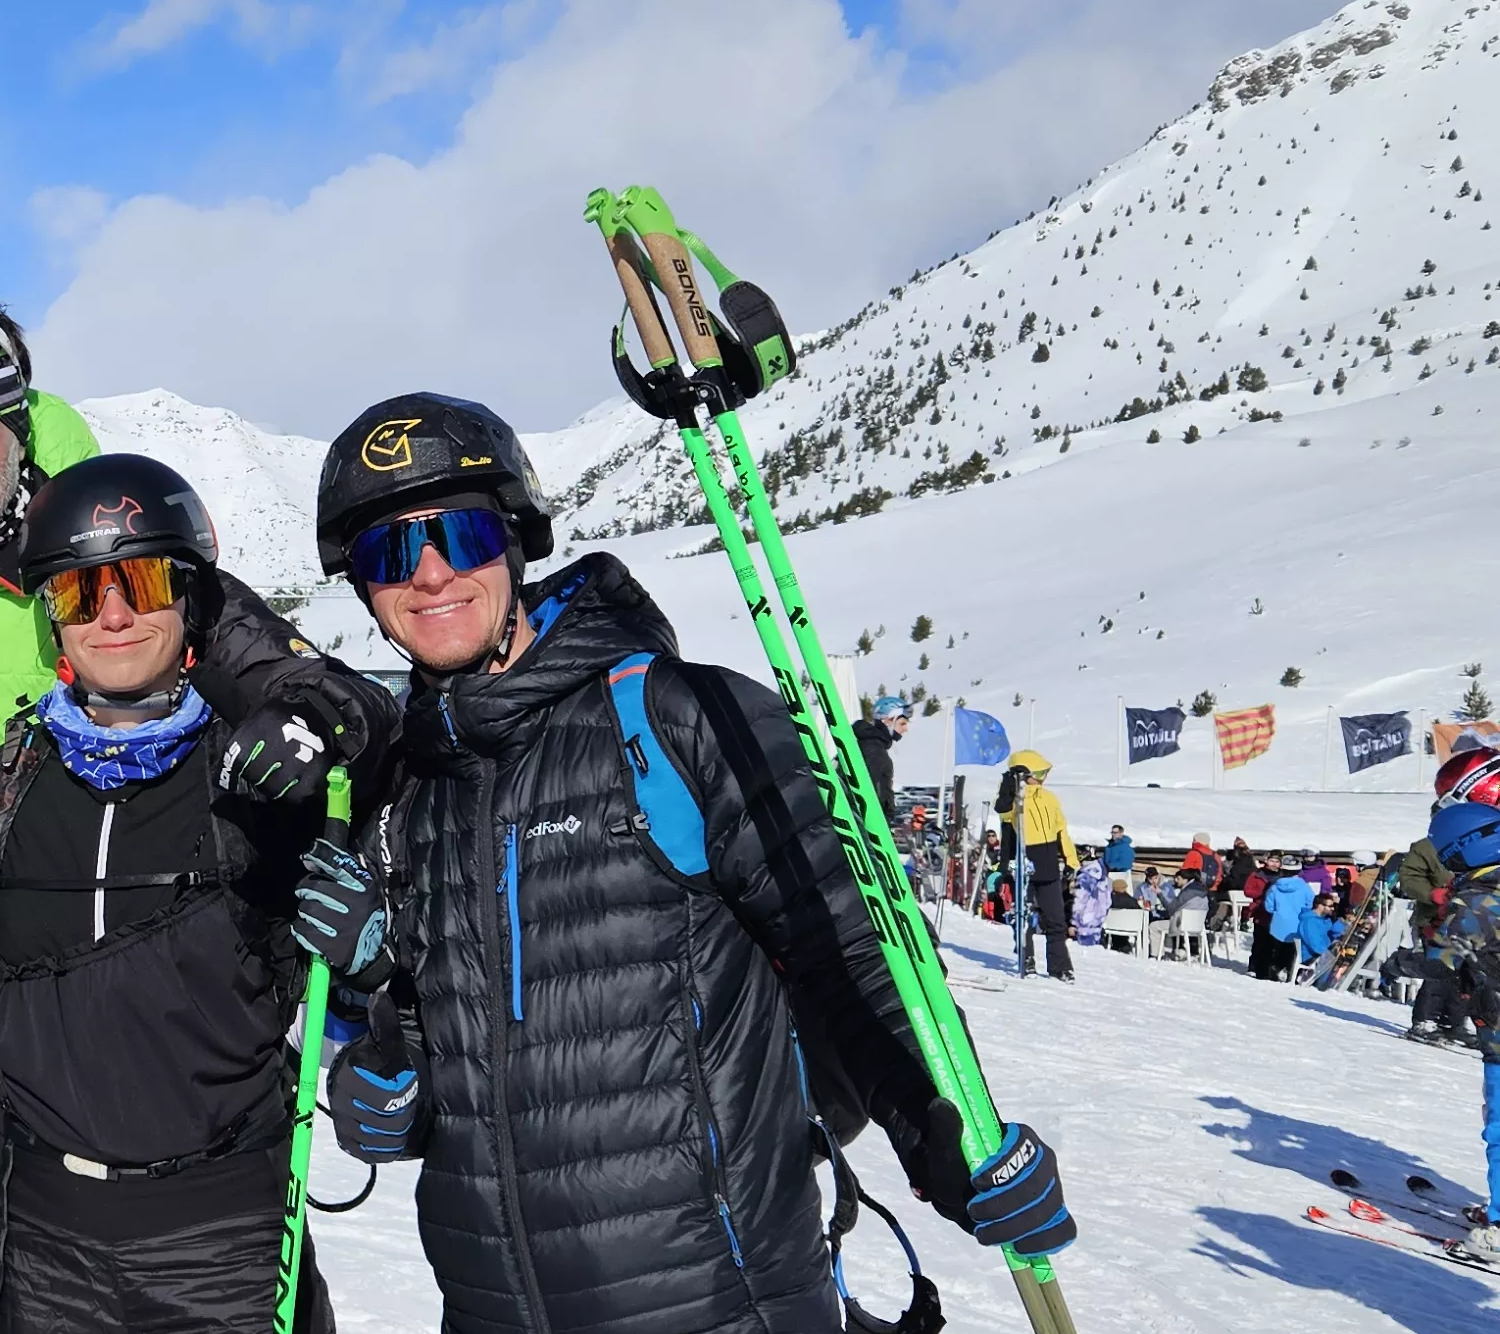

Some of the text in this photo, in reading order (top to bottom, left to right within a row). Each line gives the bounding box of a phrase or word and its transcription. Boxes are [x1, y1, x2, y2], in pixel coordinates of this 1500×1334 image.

[672, 258, 712, 337] BONES
[219, 741, 242, 791] BONES
[525, 820, 565, 839] edFox
[772, 664, 899, 948] BONES
[379, 804, 393, 864] CAMP
[911, 1007, 939, 1056] SKIMO
[992, 1138, 1036, 1185] KV+
